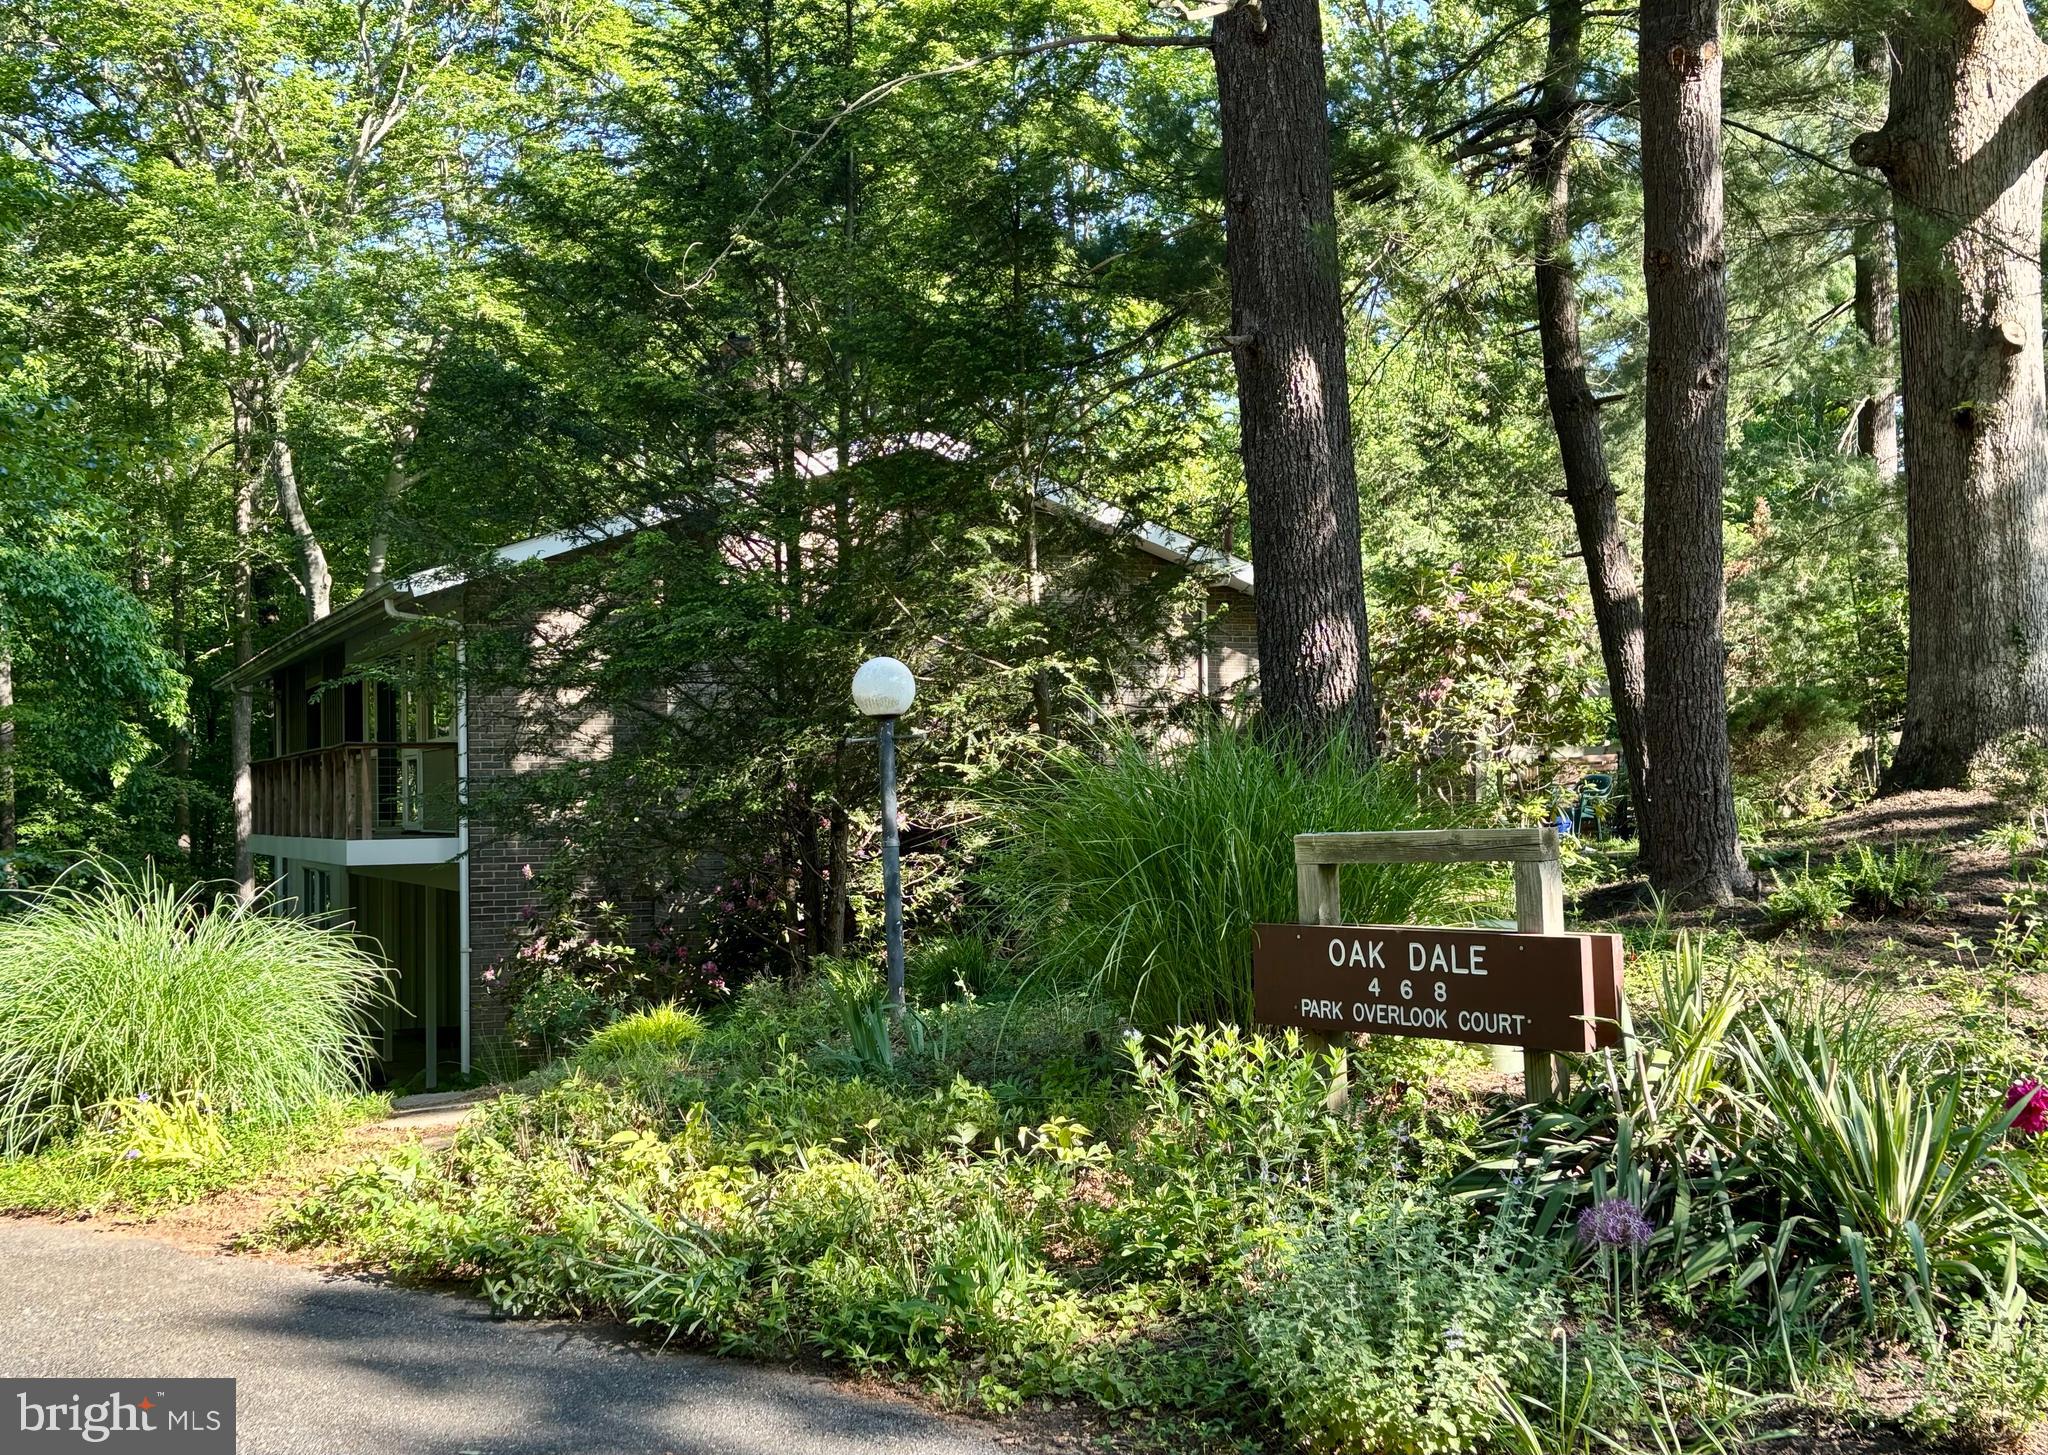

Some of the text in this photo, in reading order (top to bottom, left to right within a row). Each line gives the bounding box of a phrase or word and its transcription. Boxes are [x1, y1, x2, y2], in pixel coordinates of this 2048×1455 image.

[1328, 938, 1489, 976] OAK DALE
[1301, 998, 1525, 1036] PARK OVERLOOK COURT
